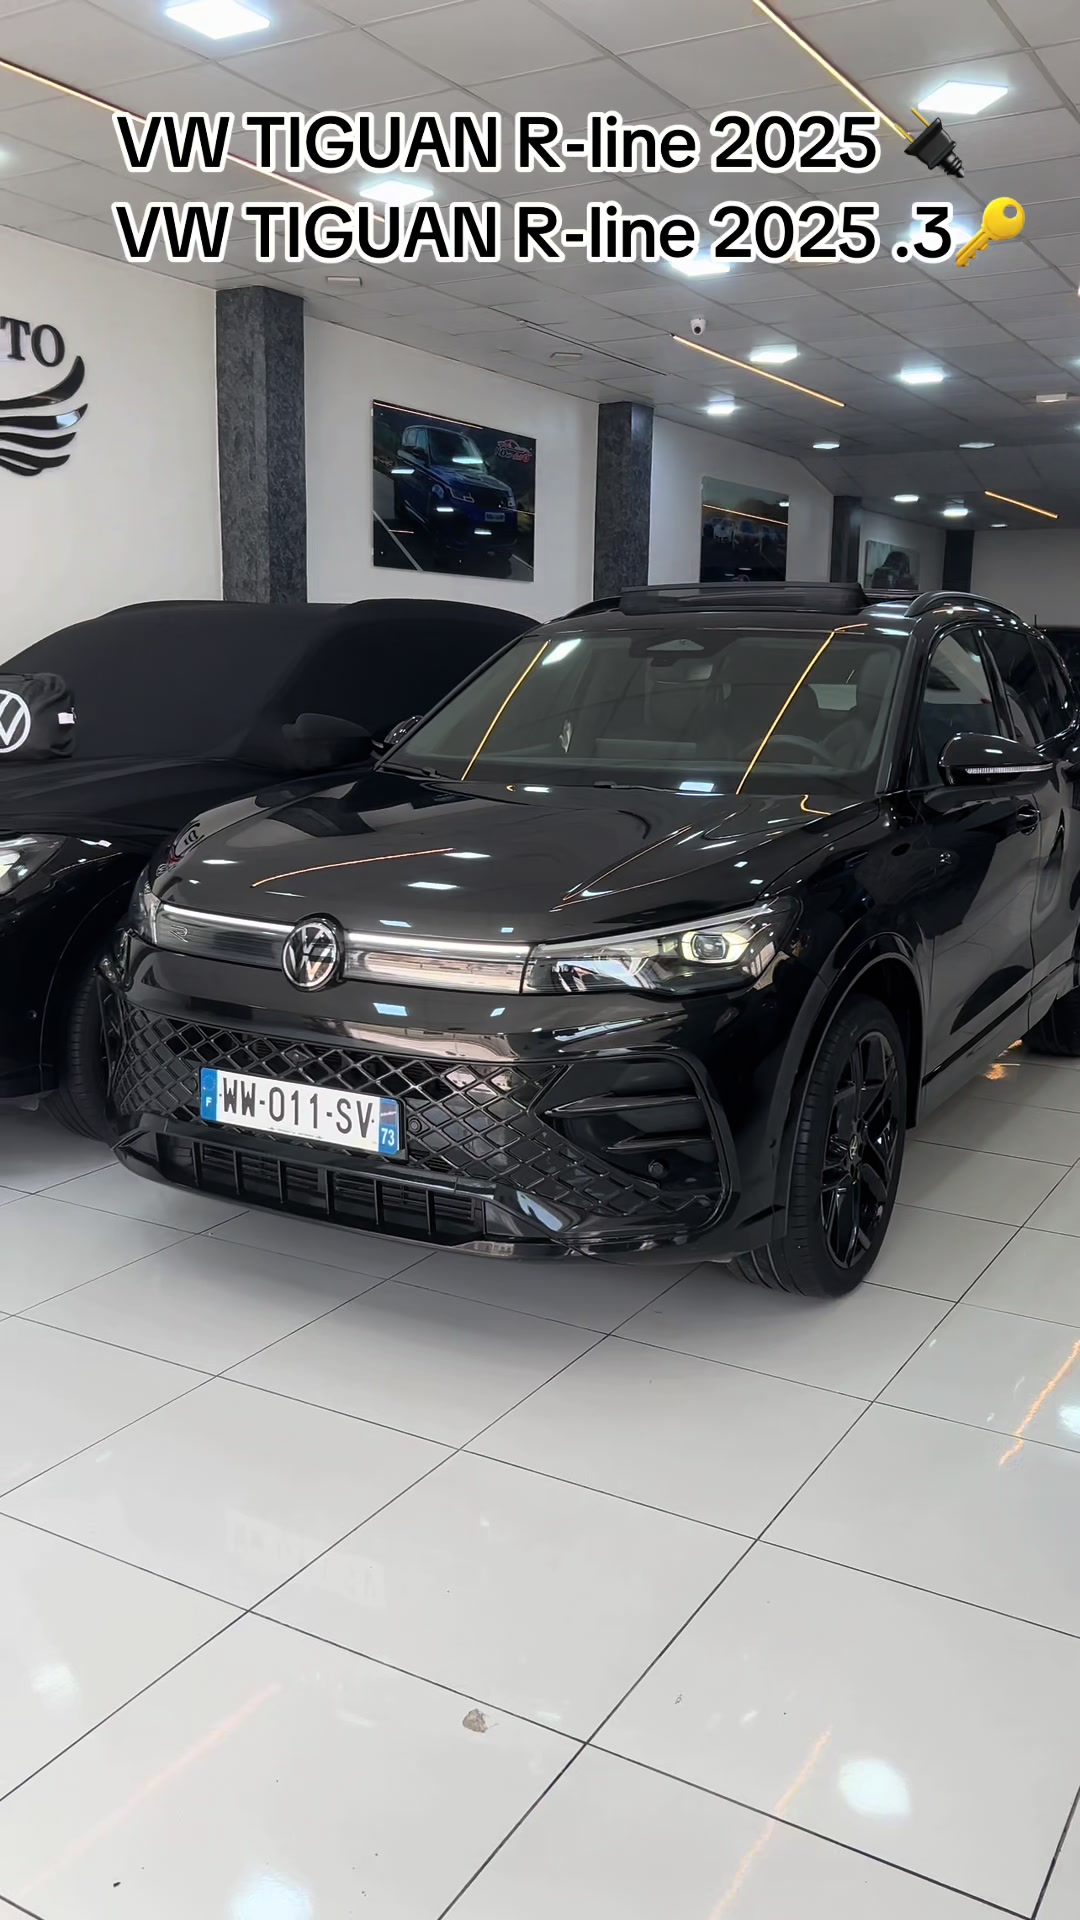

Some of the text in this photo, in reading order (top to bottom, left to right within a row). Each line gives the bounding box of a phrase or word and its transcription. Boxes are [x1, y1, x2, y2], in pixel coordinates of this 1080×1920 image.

[205, 1097, 212, 1108] F
[222, 1077, 374, 1139] WW-011-SV
[380, 1127, 395, 1147] 73
